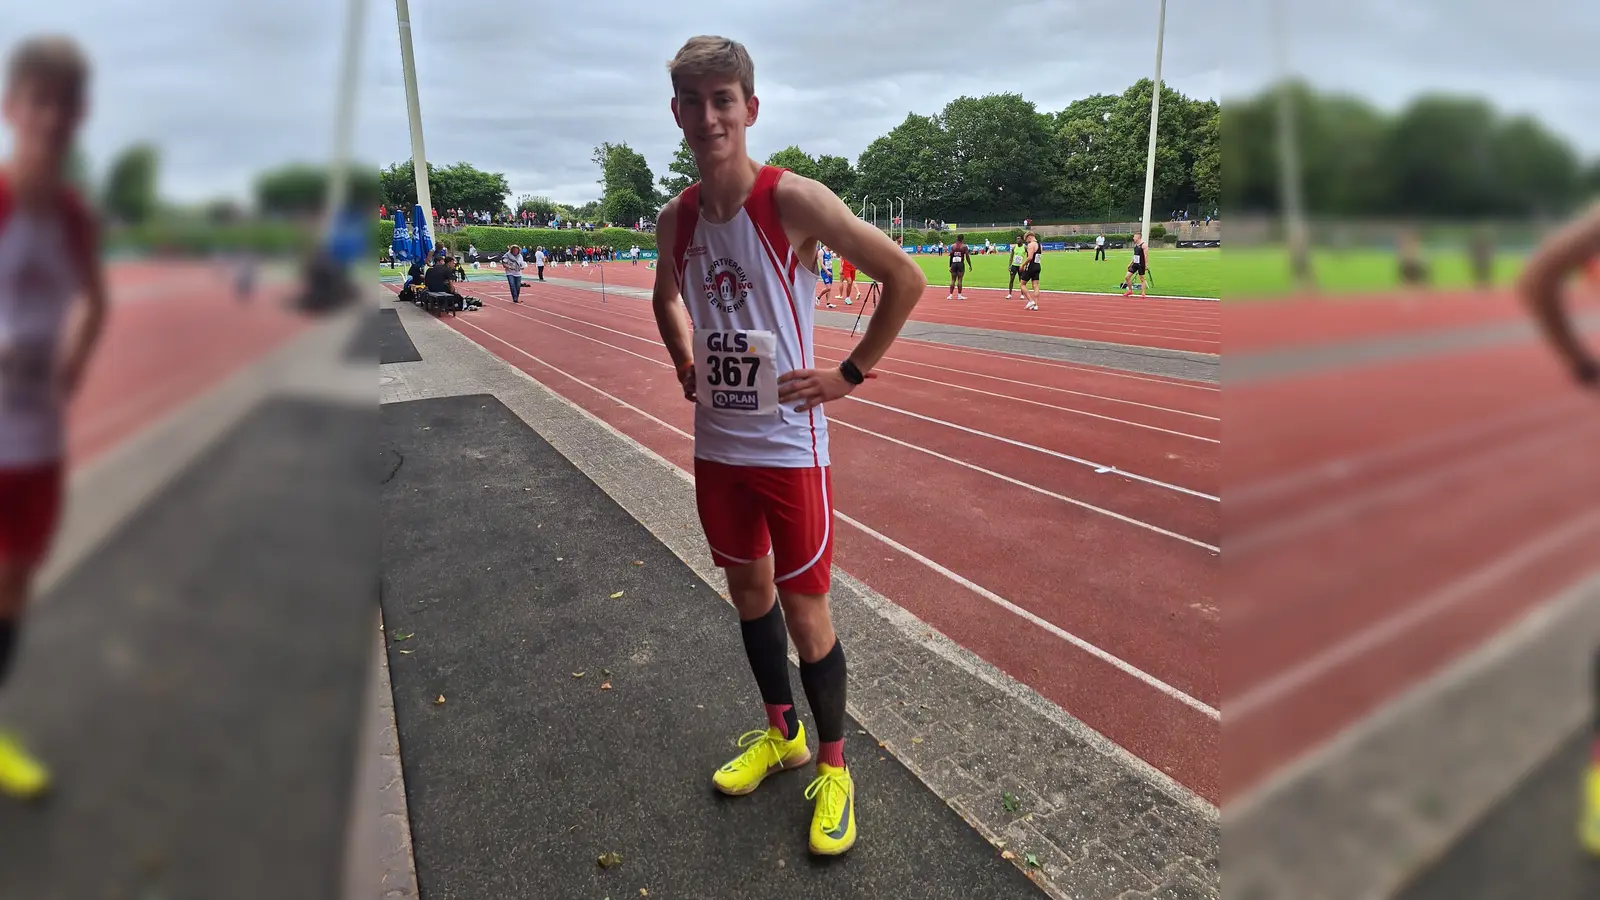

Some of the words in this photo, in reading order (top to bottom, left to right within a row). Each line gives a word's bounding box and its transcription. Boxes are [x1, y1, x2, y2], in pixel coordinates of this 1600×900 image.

[705, 257, 747, 283] SPORTVEREIN
[706, 354, 761, 387] 367
[729, 394, 756, 404] PLAN
